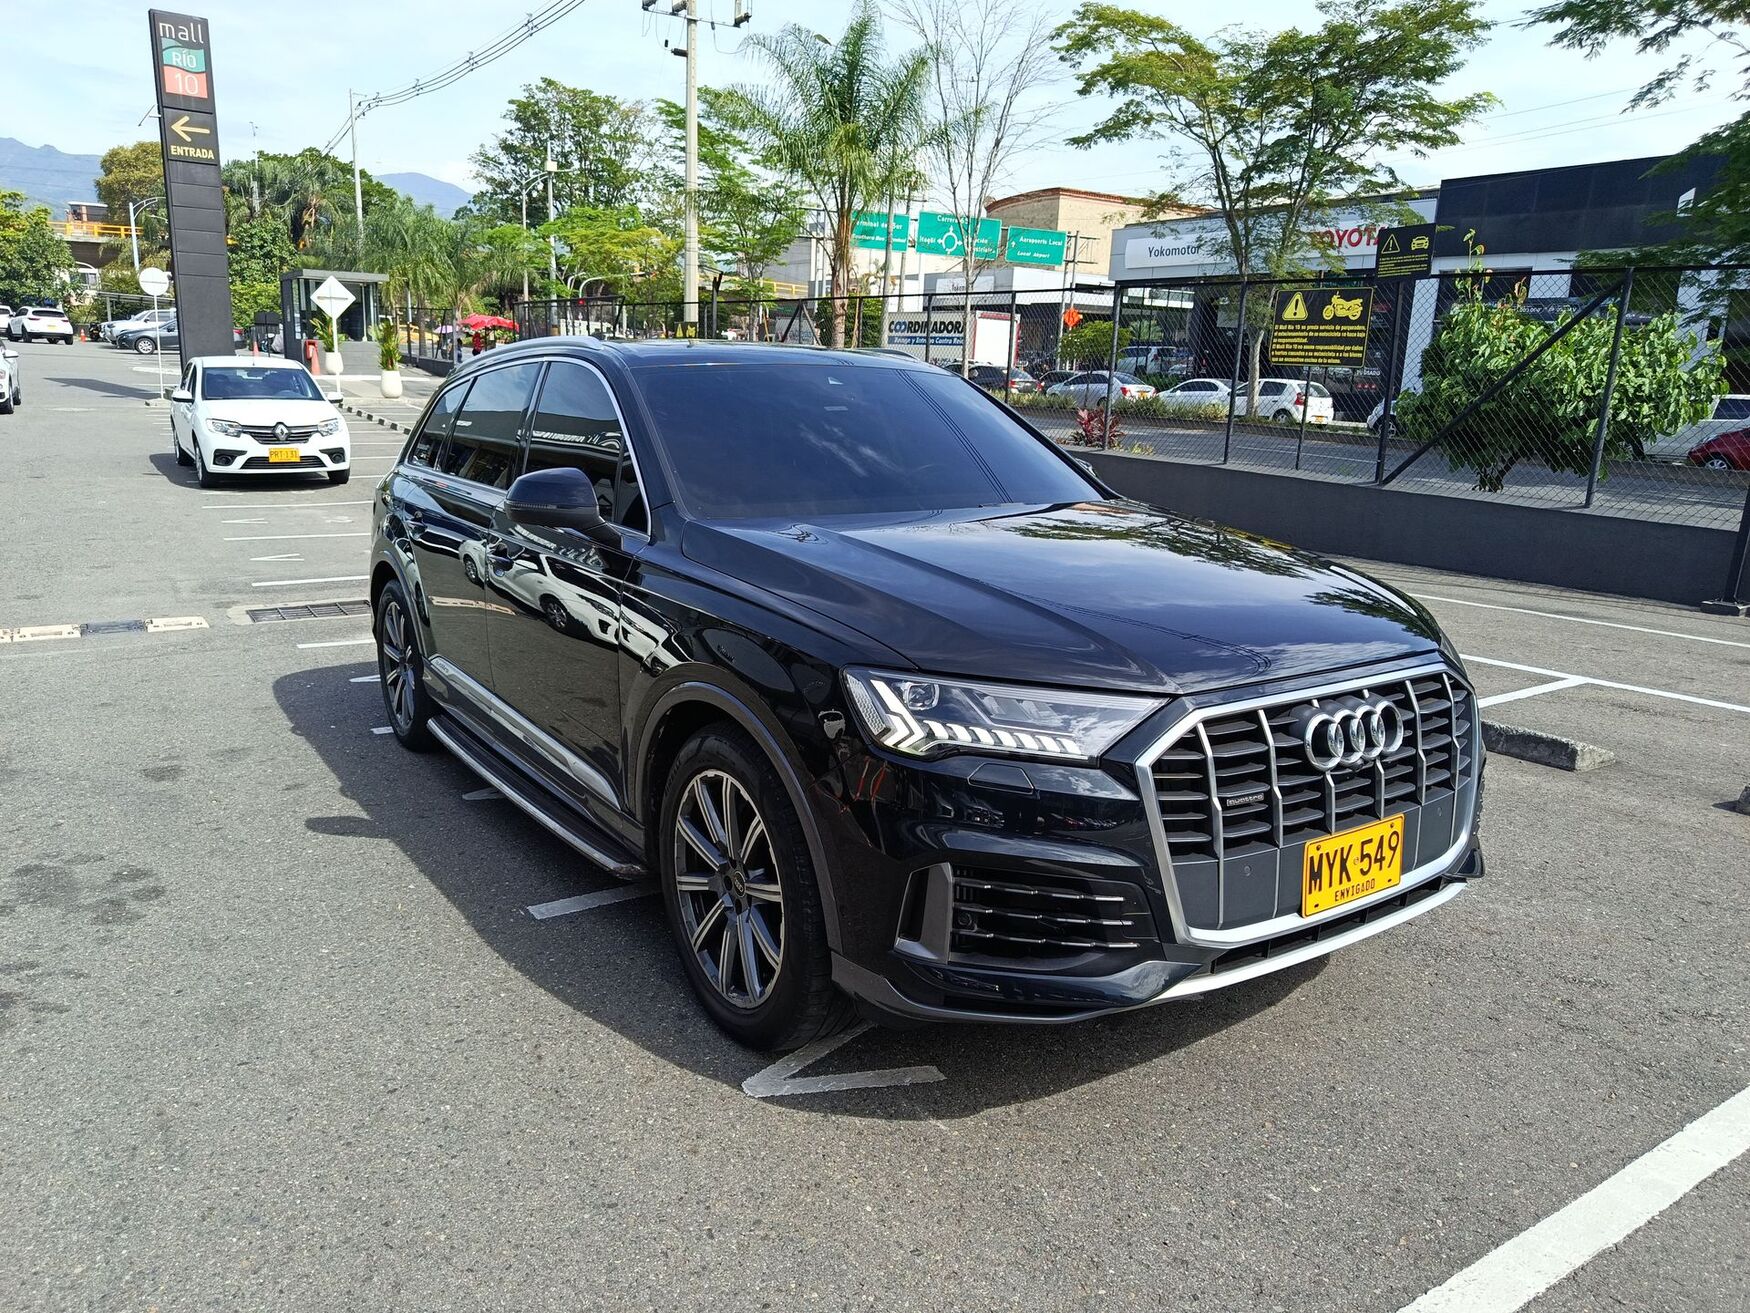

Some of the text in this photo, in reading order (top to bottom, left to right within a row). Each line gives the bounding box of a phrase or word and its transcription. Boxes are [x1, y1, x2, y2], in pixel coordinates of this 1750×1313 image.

[159, 22, 204, 44] mall
[175, 74, 198, 95] 10
[170, 145, 215, 160] ENTRADA
[1308, 830, 1399, 895] MYK 549
[1334, 878, 1376, 902] ENVIGADO
